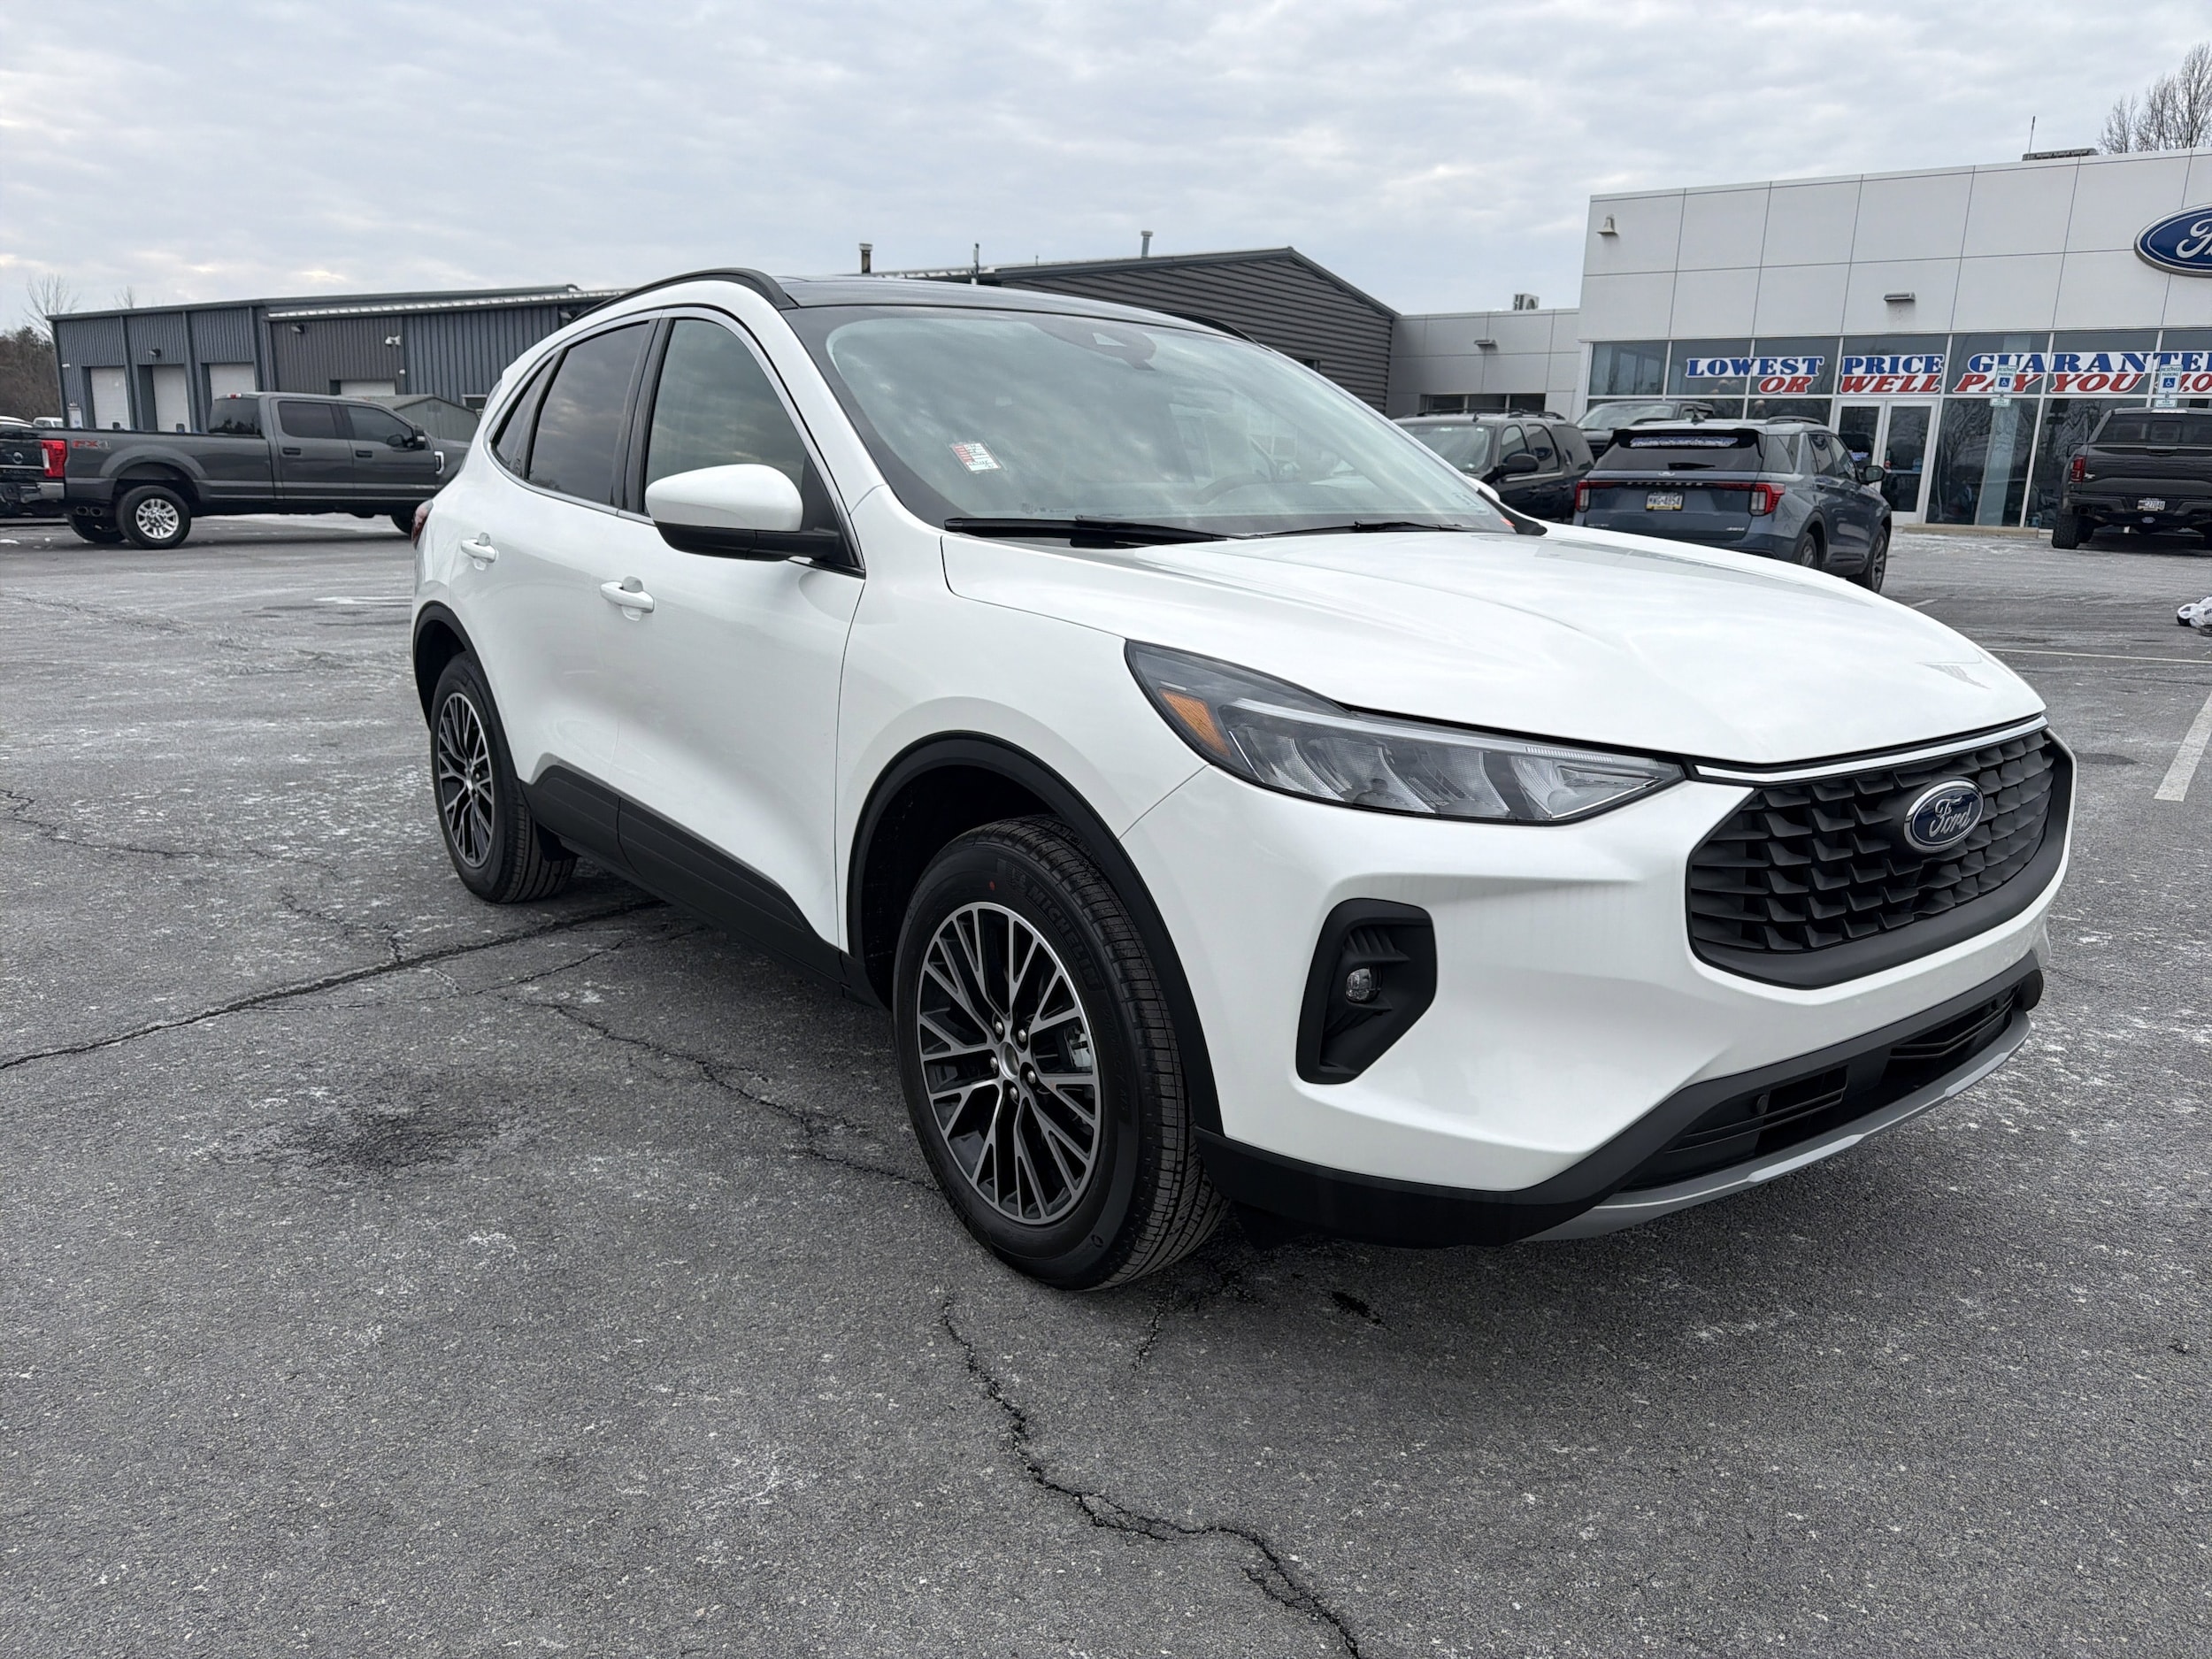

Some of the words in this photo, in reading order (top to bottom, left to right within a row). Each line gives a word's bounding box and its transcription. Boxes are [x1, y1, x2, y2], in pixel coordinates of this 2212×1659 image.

[1686, 357, 1824, 376] LOWEST
[1842, 356, 1944, 375] PRICE
[1758, 376, 1812, 393] OR
[1841, 375, 1939, 393] WE'LL
[2052, 373, 2143, 392] YOU
[1929, 796, 1973, 838] Ford
[1028, 886, 1100, 987] MICHELIN
